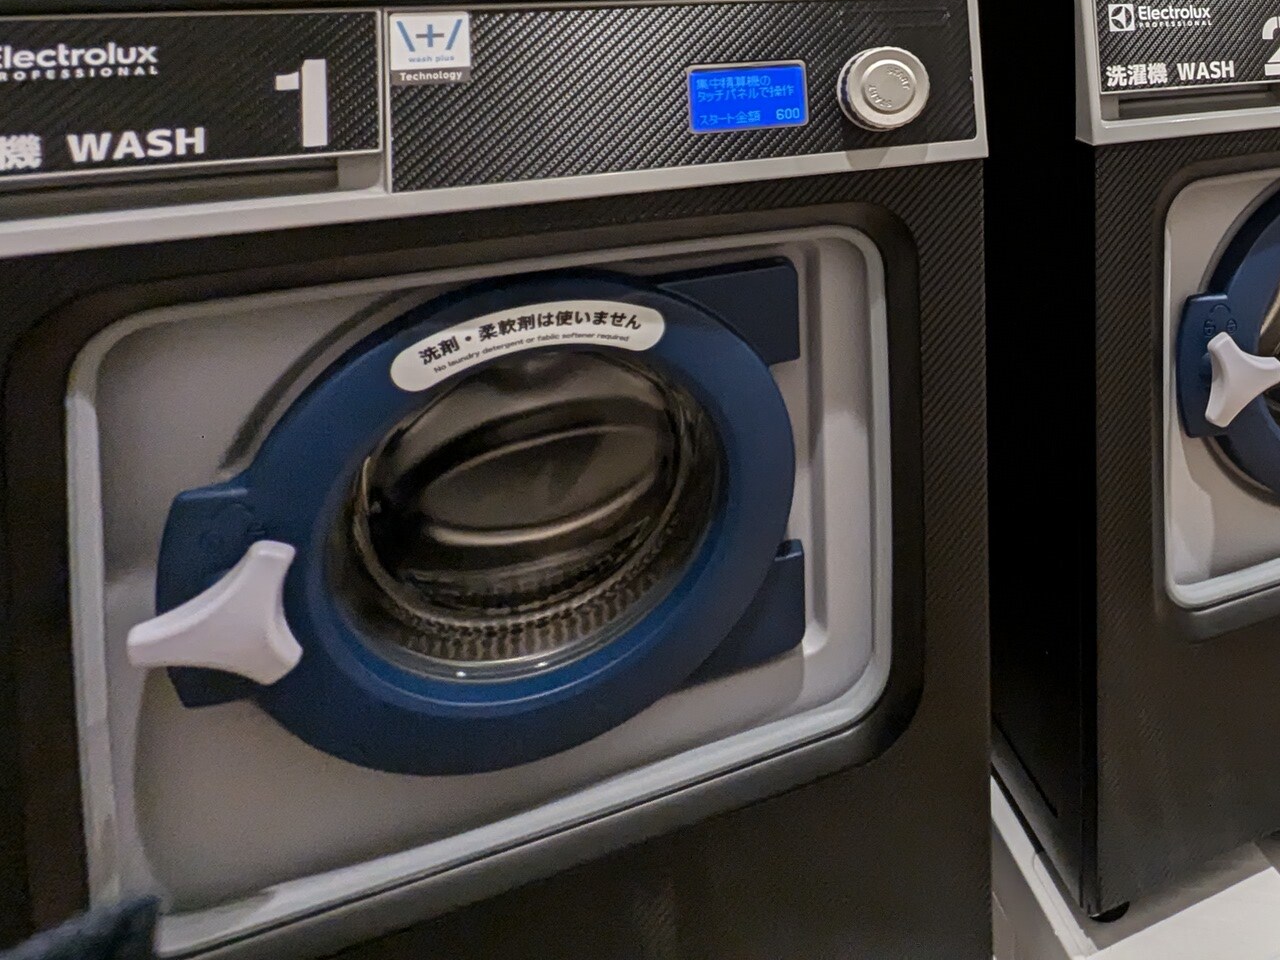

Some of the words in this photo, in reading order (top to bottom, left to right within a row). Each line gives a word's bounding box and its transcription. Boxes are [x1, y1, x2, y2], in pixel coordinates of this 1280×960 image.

[1138, 4, 1211, 20] Electrolux
[1139, 20, 1213, 28] PROFESSIONAL
[0, 42, 159, 69] lectrolux
[400, 70, 463, 81] Technology
[1105, 62, 1168, 87] 洗濯機
[1176, 60, 1235, 81] WASH
[275, 59, 328, 147] 1
[776, 107, 800, 120] 600
[66, 127, 205, 163] WASH
[418, 310, 642, 364] 洗剤・柔軟剤は使いません
[433, 364, 447, 373] No
[447, 350, 480, 367] laundry
[482, 339, 524, 354] detergent
[597, 333, 630, 342] required
